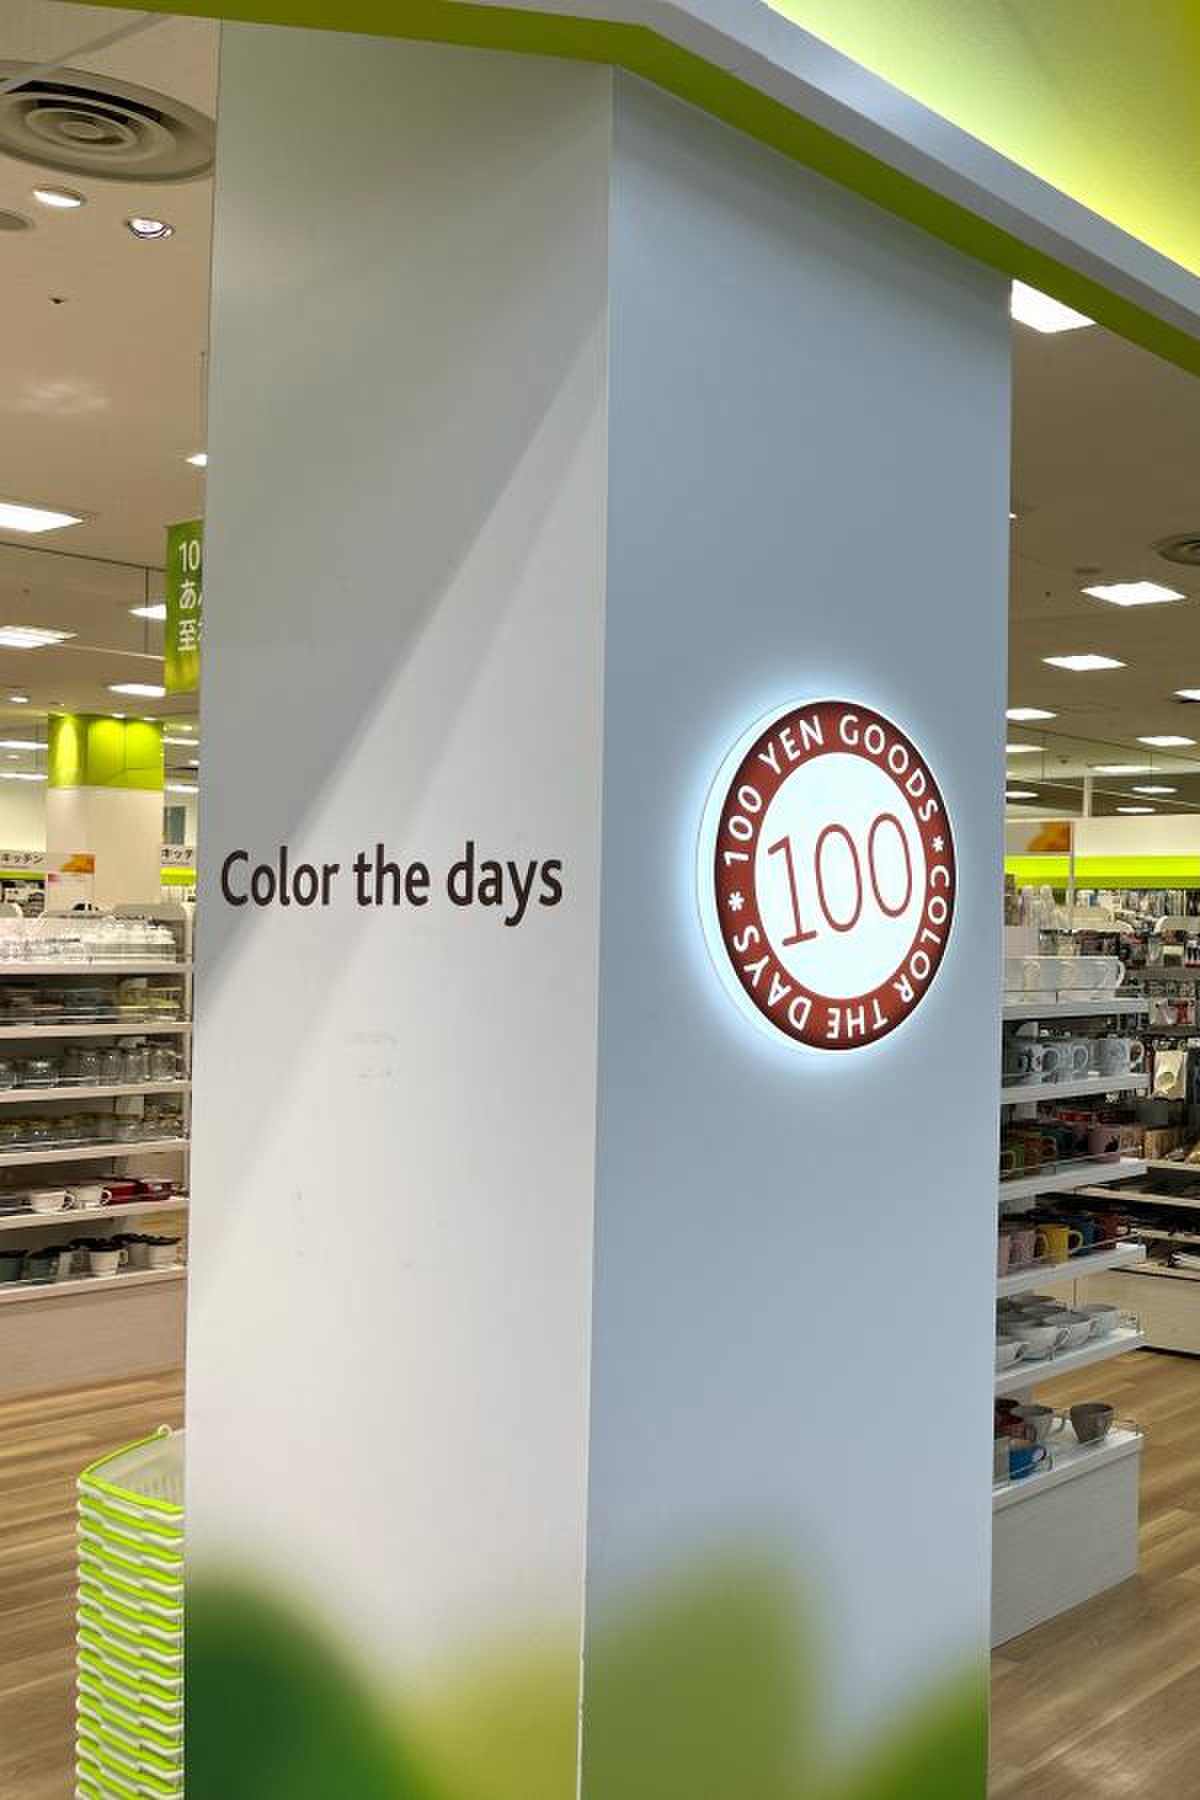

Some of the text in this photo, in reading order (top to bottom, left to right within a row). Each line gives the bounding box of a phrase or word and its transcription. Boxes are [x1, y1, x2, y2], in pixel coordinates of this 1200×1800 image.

[177, 619, 204, 652] 至
[178, 578, 203, 609] あ
[220, 840, 564, 928] Color the days
[724, 713, 951, 1039] 100 YEN GOODS COLOR THE DAYS
[767, 812, 913, 948] 100
